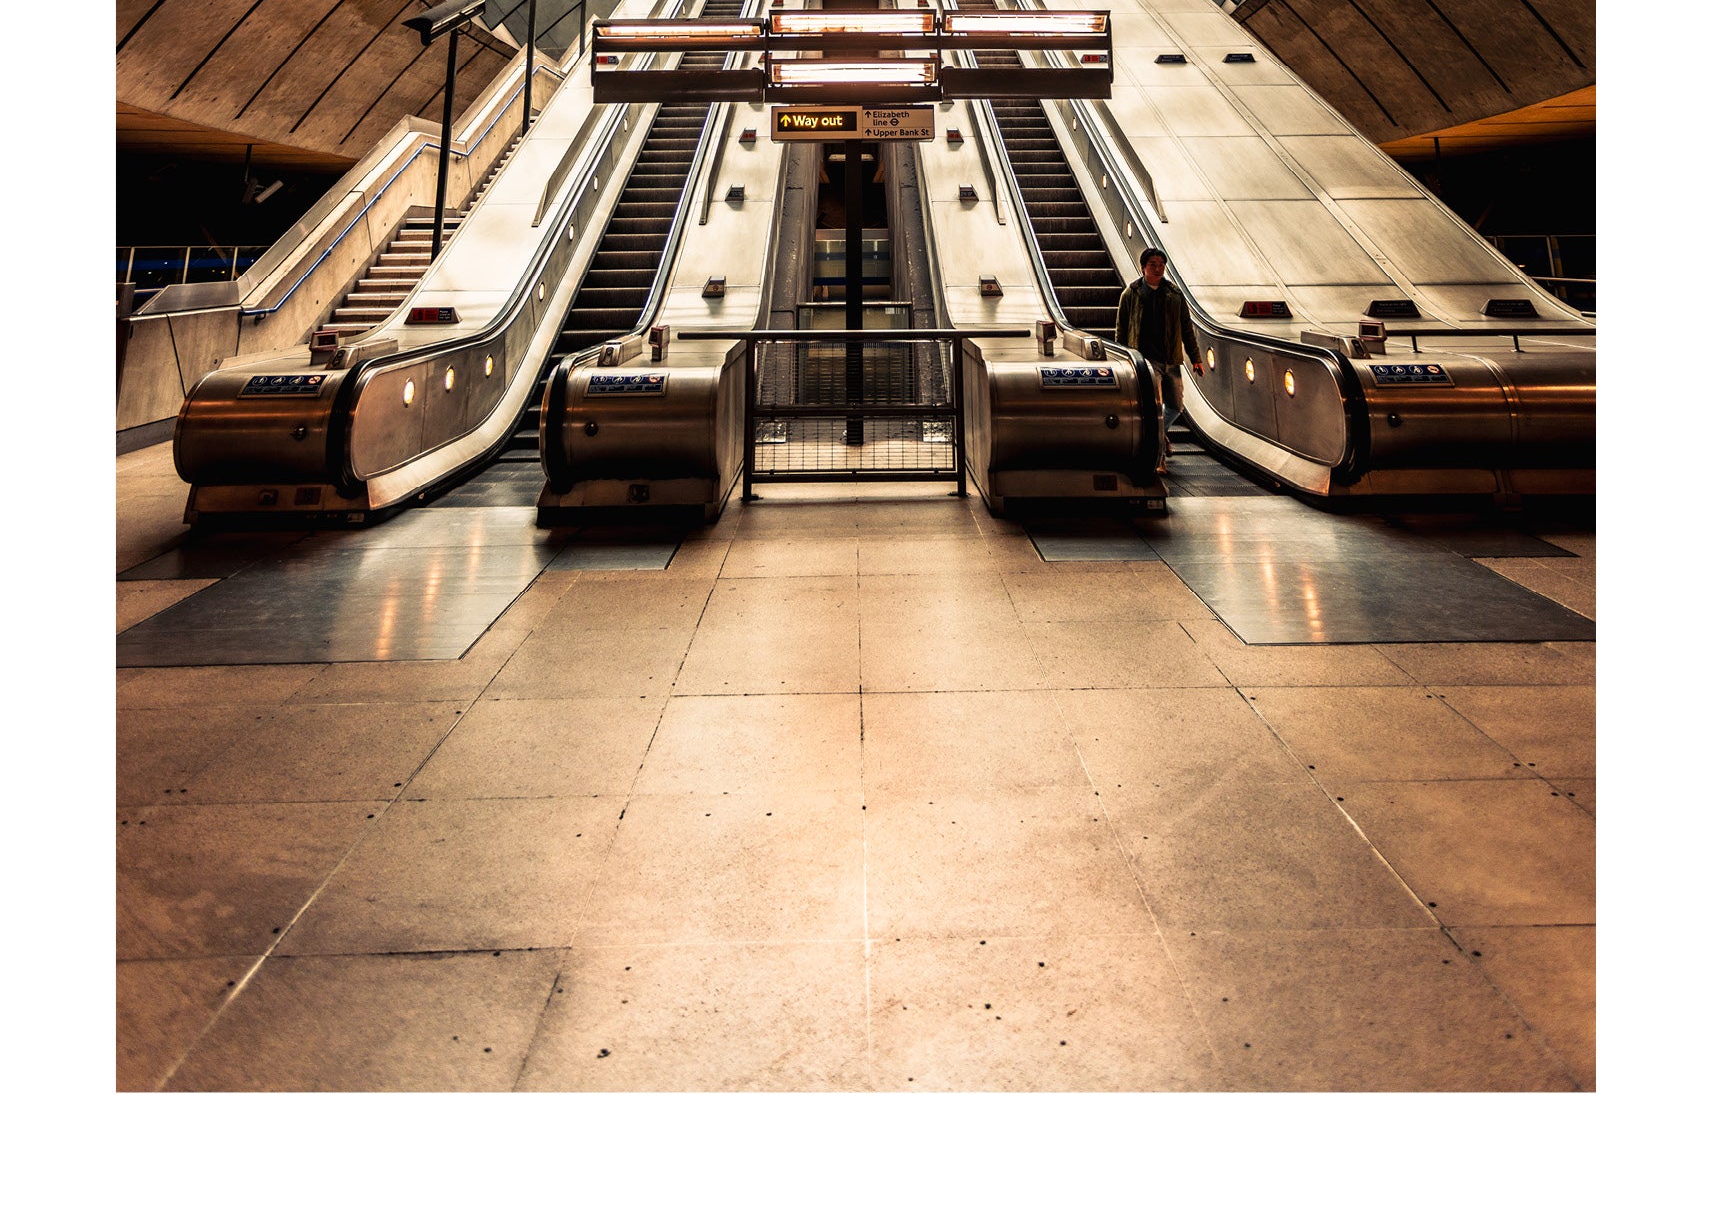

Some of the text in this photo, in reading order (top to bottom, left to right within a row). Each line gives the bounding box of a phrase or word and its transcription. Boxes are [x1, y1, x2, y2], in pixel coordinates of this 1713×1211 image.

[872, 110, 910, 118] Elizabeth
[792, 115, 843, 128] Way out
[873, 128, 930, 137] Upper Bank St
